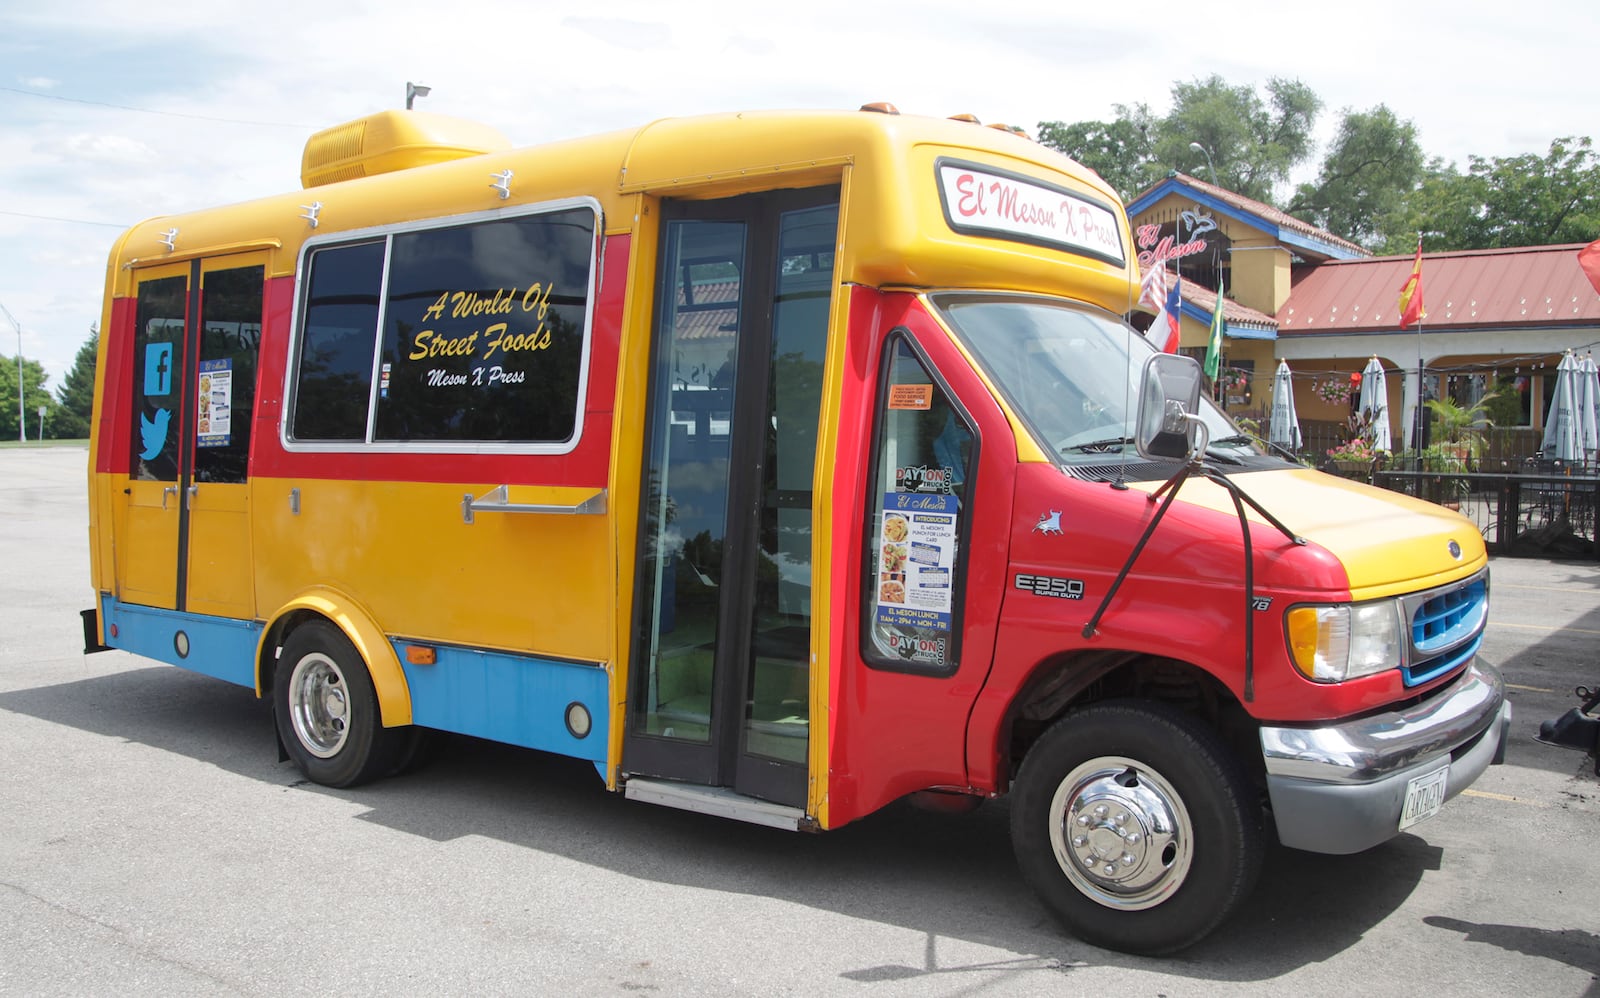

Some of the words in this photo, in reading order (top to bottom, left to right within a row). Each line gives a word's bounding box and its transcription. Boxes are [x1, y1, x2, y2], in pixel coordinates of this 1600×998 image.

[956, 174, 987, 217] El
[990, 182, 1056, 229] Meson
[1060, 201, 1076, 237] X
[1079, 206, 1117, 248] Press
[1136, 223, 1162, 249] El
[1137, 234, 1207, 265] Meson
[422, 291, 449, 322] A
[451, 287, 517, 319] World
[522, 282, 553, 321] Of
[408, 330, 478, 360] Street
[483, 321, 552, 360] Foods
[427, 368, 467, 386] Meson
[472, 366, 486, 386] X
[488, 365, 525, 385] Press
[895, 468, 944, 482] DAYTON
[943, 467, 953, 494] FOOD
[897, 494, 911, 508] El
[911, 496, 946, 510] Meson
[1035, 589, 1059, 597] SUPER
[896, 608, 918, 617] MESON
[918, 610, 939, 619] LUNCH
[898, 617, 911, 625] 2PM
[917, 618, 932, 627] MON
[937, 621, 947, 629] FRI
[889, 635, 938, 652] DAYTON
[916, 650, 937, 658] TRUCK
[936, 638, 945, 665] FOOD
